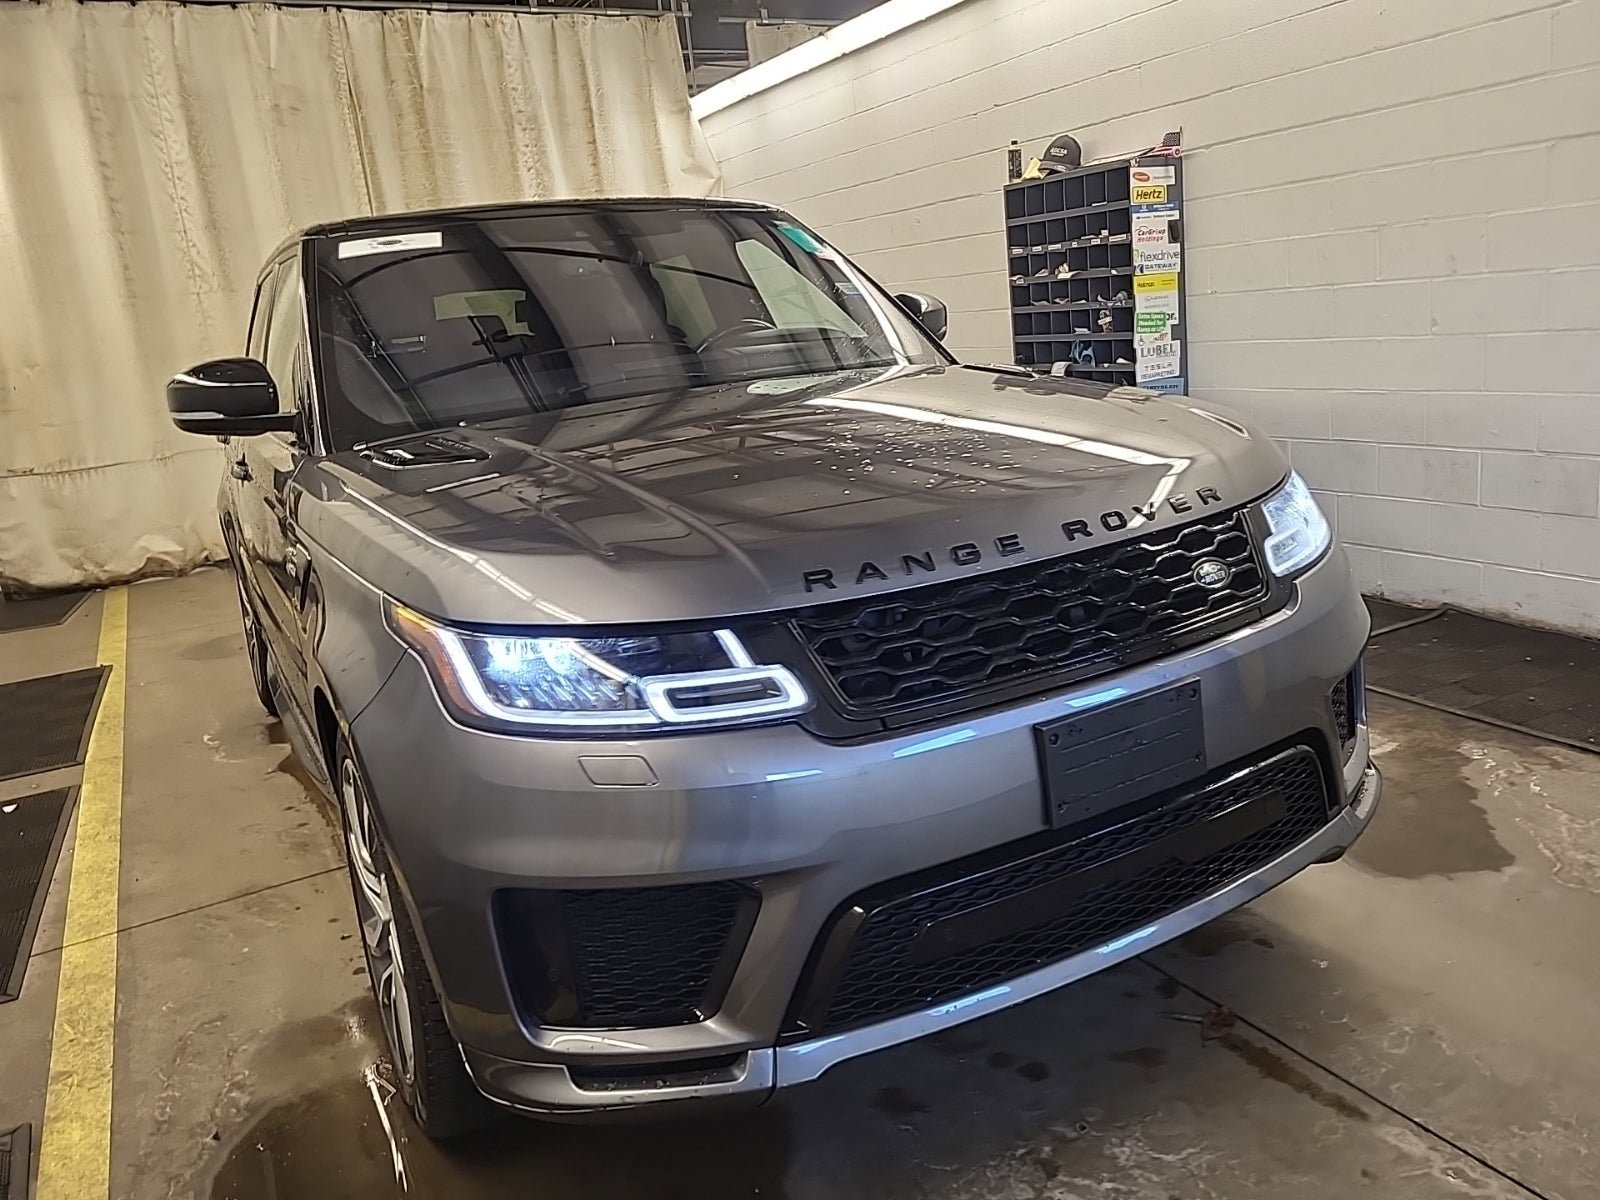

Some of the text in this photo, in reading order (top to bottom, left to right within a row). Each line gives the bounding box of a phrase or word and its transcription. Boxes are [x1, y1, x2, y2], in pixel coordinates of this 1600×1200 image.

[1136, 189, 1163, 200] Hertz
[1139, 249, 1180, 262] flexdrive
[1144, 362, 1173, 371] TESLA
[803, 486, 1223, 594] RANGE ROVER
